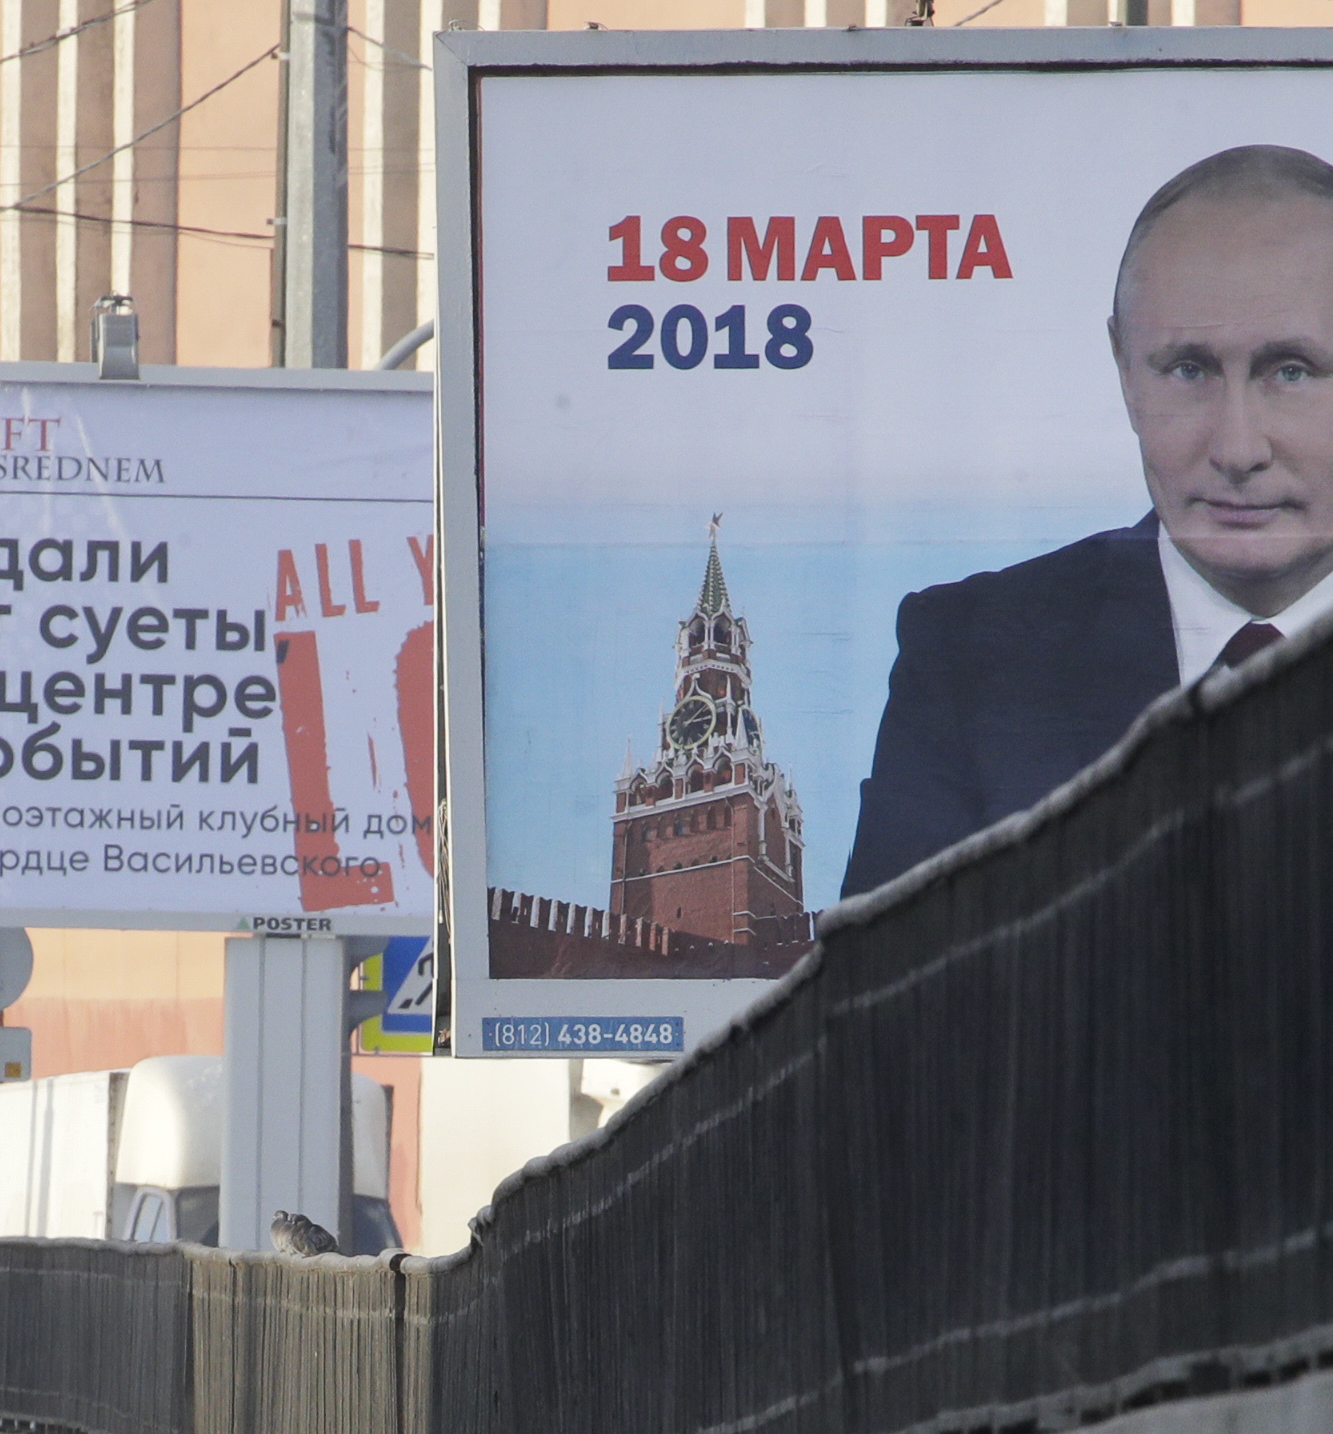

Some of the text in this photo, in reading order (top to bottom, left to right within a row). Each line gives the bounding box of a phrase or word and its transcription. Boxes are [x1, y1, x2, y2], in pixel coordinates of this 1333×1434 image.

[606, 214, 1014, 282] 18 МАРТА
[606, 303, 814, 370] 2018
[275, 538, 380, 622] ALL
[198, 804, 350, 839] клубный
[363, 813, 432, 840] дом
[104, 843, 381, 878] Васильевского
[253, 917, 332, 931] POSTER
[495, 1022, 673, 1047] (812) 438-4848
